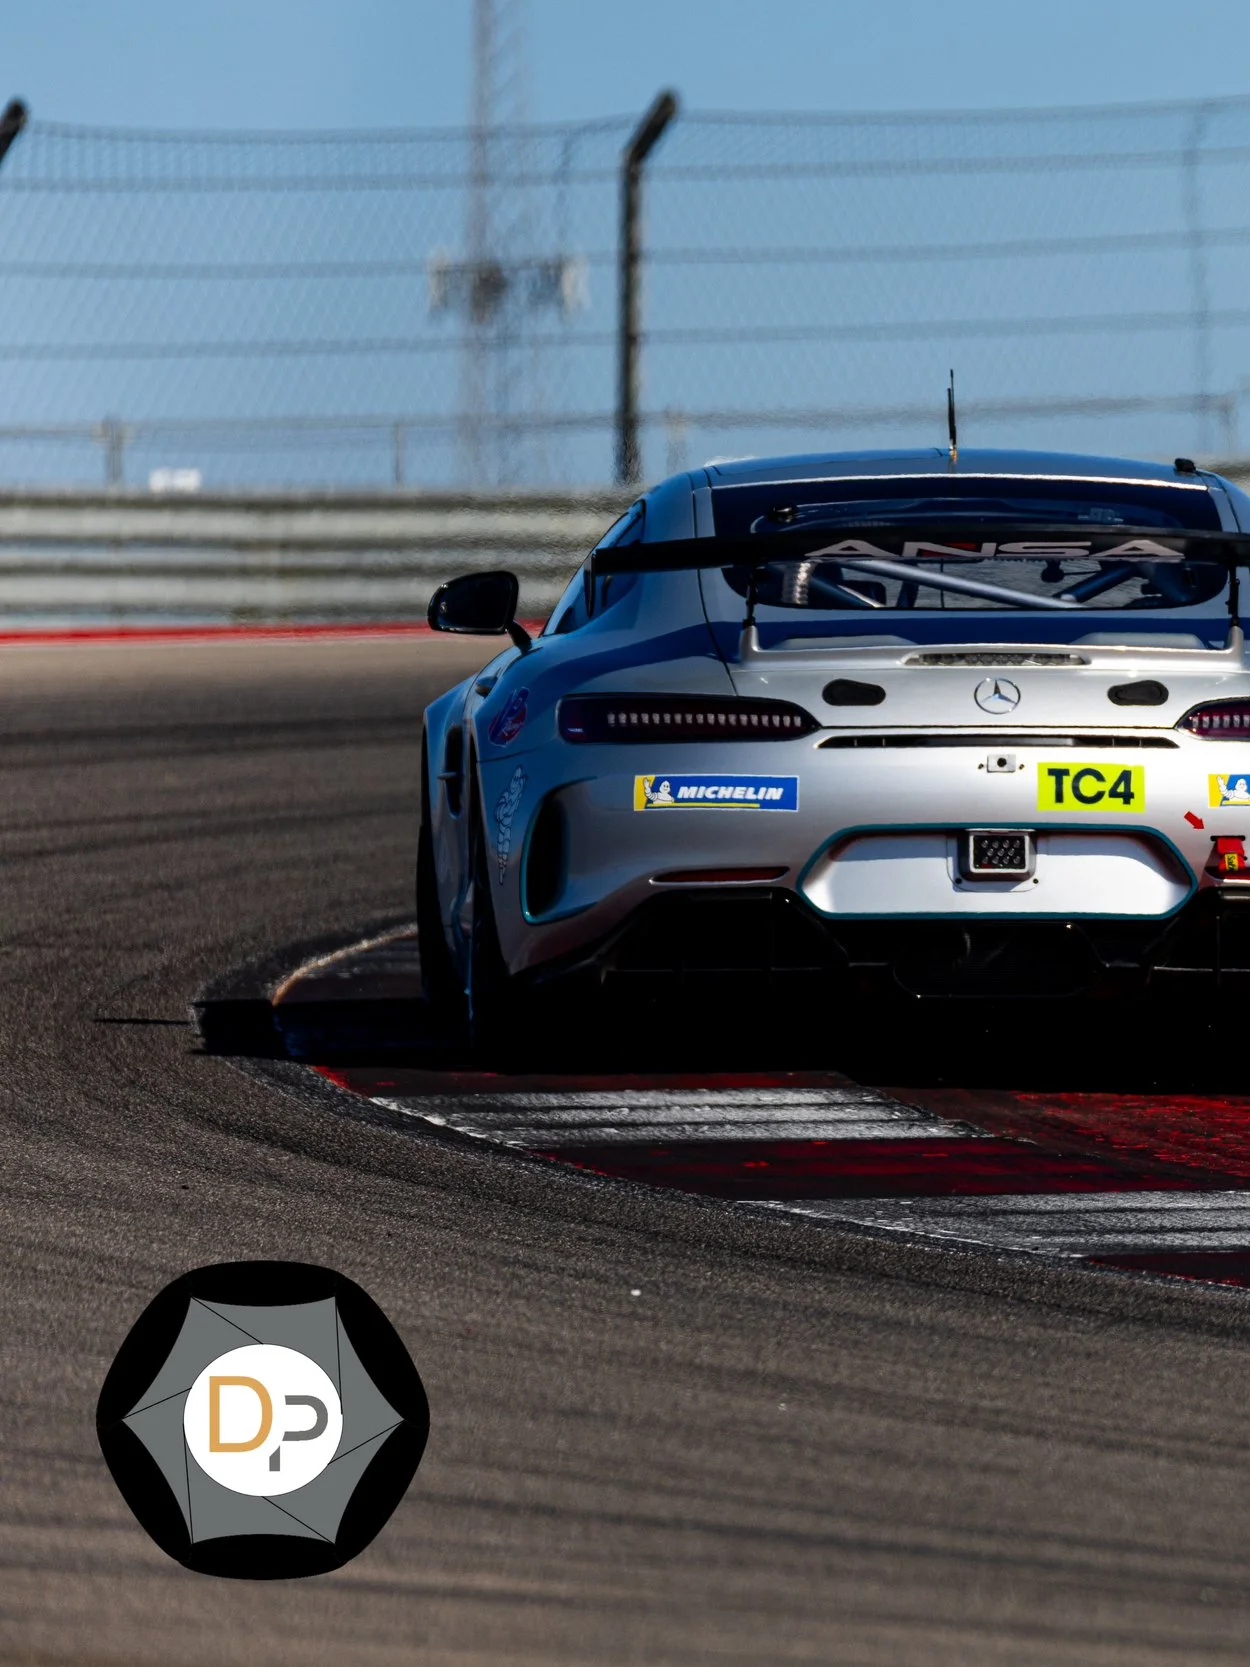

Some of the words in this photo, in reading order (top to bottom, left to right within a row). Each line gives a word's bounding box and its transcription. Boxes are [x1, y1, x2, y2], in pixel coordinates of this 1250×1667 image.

[803, 539, 1185, 558] ANSA
[677, 785, 783, 801] MICHELIN
[1047, 768, 1135, 805] TC4
